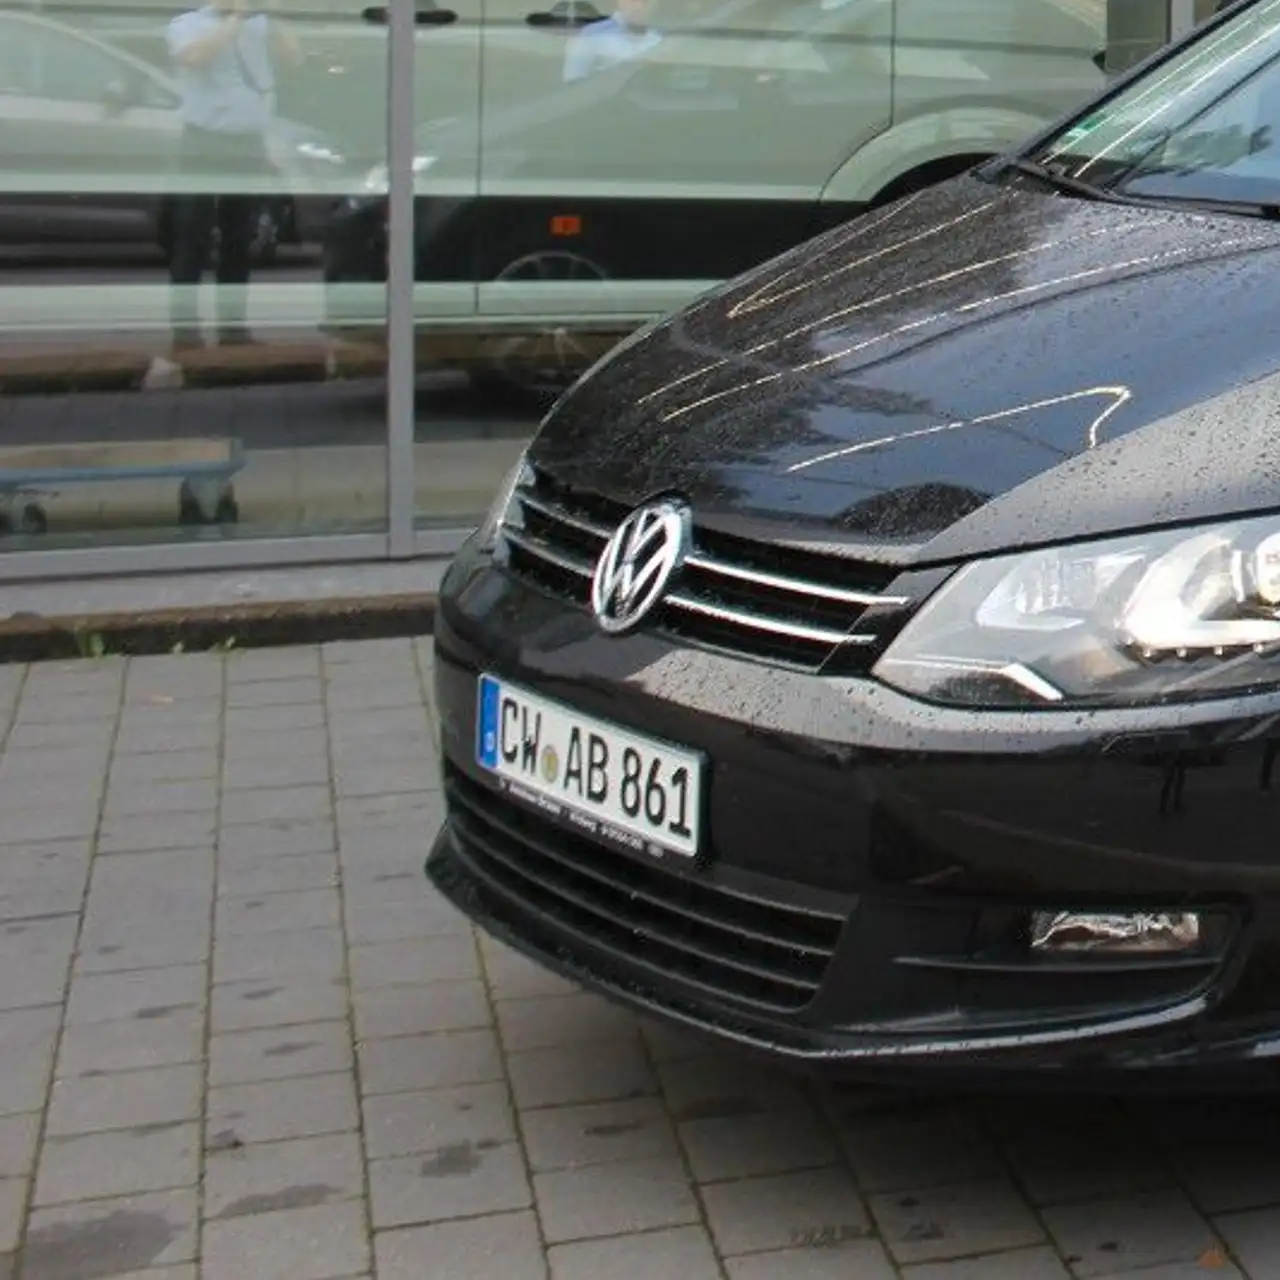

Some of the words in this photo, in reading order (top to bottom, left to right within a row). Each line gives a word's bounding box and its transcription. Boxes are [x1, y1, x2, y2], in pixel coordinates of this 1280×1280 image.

[500, 698, 542, 775] CW
[562, 725, 609, 804] AB
[620, 746, 692, 838] 861
